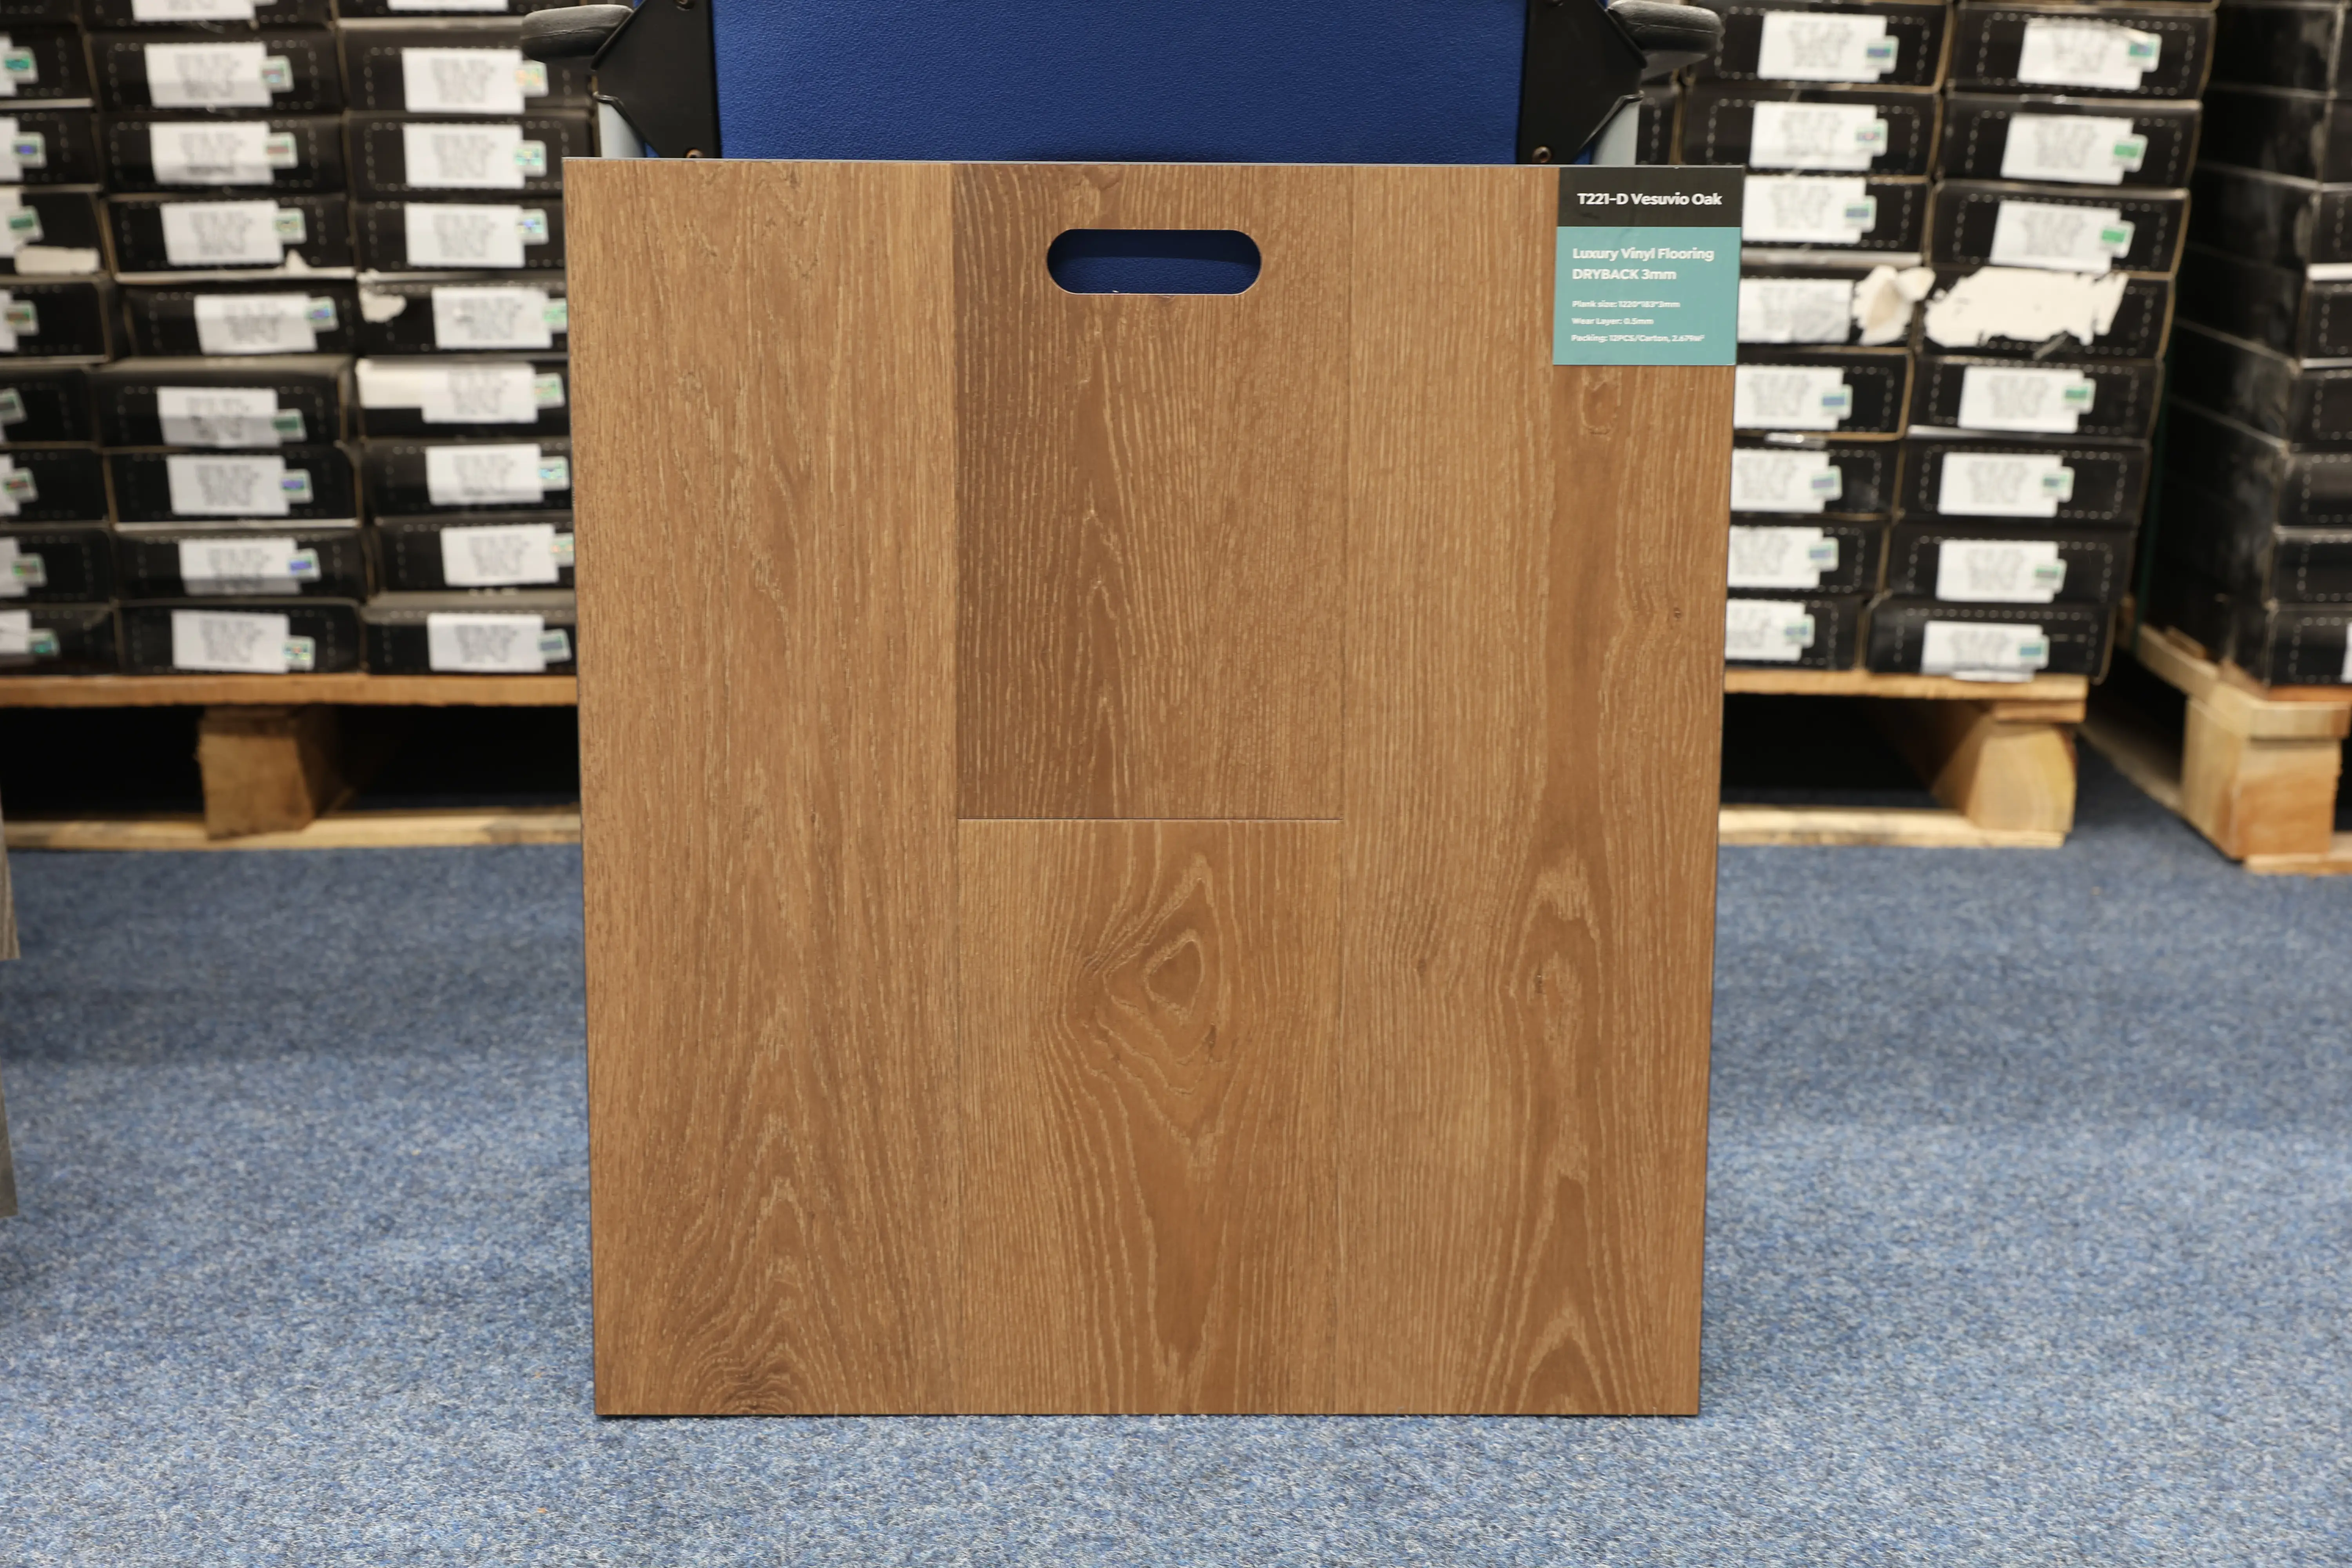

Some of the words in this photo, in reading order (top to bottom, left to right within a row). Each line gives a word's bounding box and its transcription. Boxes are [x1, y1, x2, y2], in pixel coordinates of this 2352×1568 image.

[1577, 193, 1629, 205] T221-D
[1630, 192, 1690, 205] Vesuvio
[1691, 192, 1723, 205] Oak
[1573, 248, 1619, 261] Luxury
[1621, 247, 1655, 261] Vinyl
[1657, 247, 1715, 262] Flooring
[1572, 269, 1639, 279] DRYBACK
[1641, 269, 1677, 279] 3mm
[1595, 318, 1623, 326] Layer:
[1571, 334, 1608, 343] Packing:
